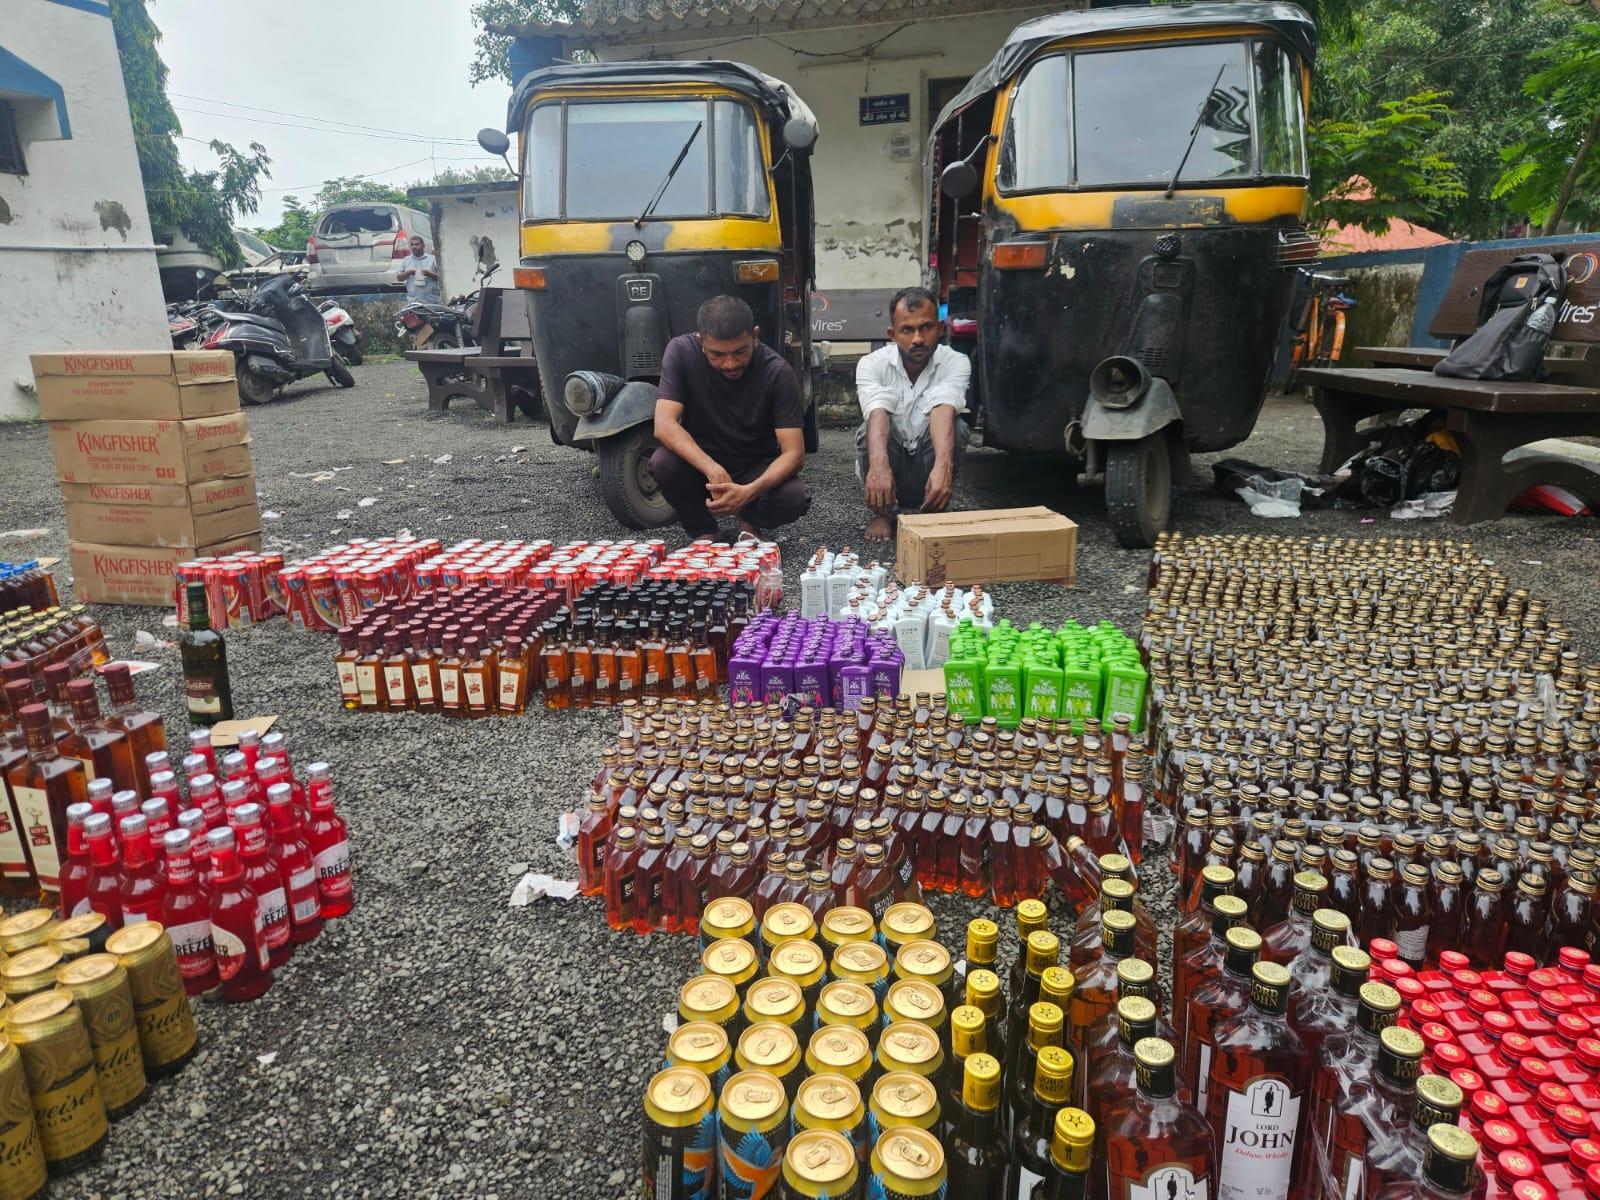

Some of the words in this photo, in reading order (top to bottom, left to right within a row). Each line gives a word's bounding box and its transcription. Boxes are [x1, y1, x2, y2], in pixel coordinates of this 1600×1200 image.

[631, 286, 648, 297] RE
[63, 355, 135, 373] KINGFISHER
[77, 431, 160, 455] KINGFISHER
[89, 484, 152, 501] KINGFISHER
[206, 486, 246, 503] KINGFISHER
[93, 554, 177, 577] KINGFISHER
[175, 934, 213, 956] REEZER
[143, 998, 187, 1034] Bud
[1255, 1123, 1279, 1131] LORD
[1226, 1124, 1296, 1149] JOHN
[1507, 1156, 1526, 1170] RC
